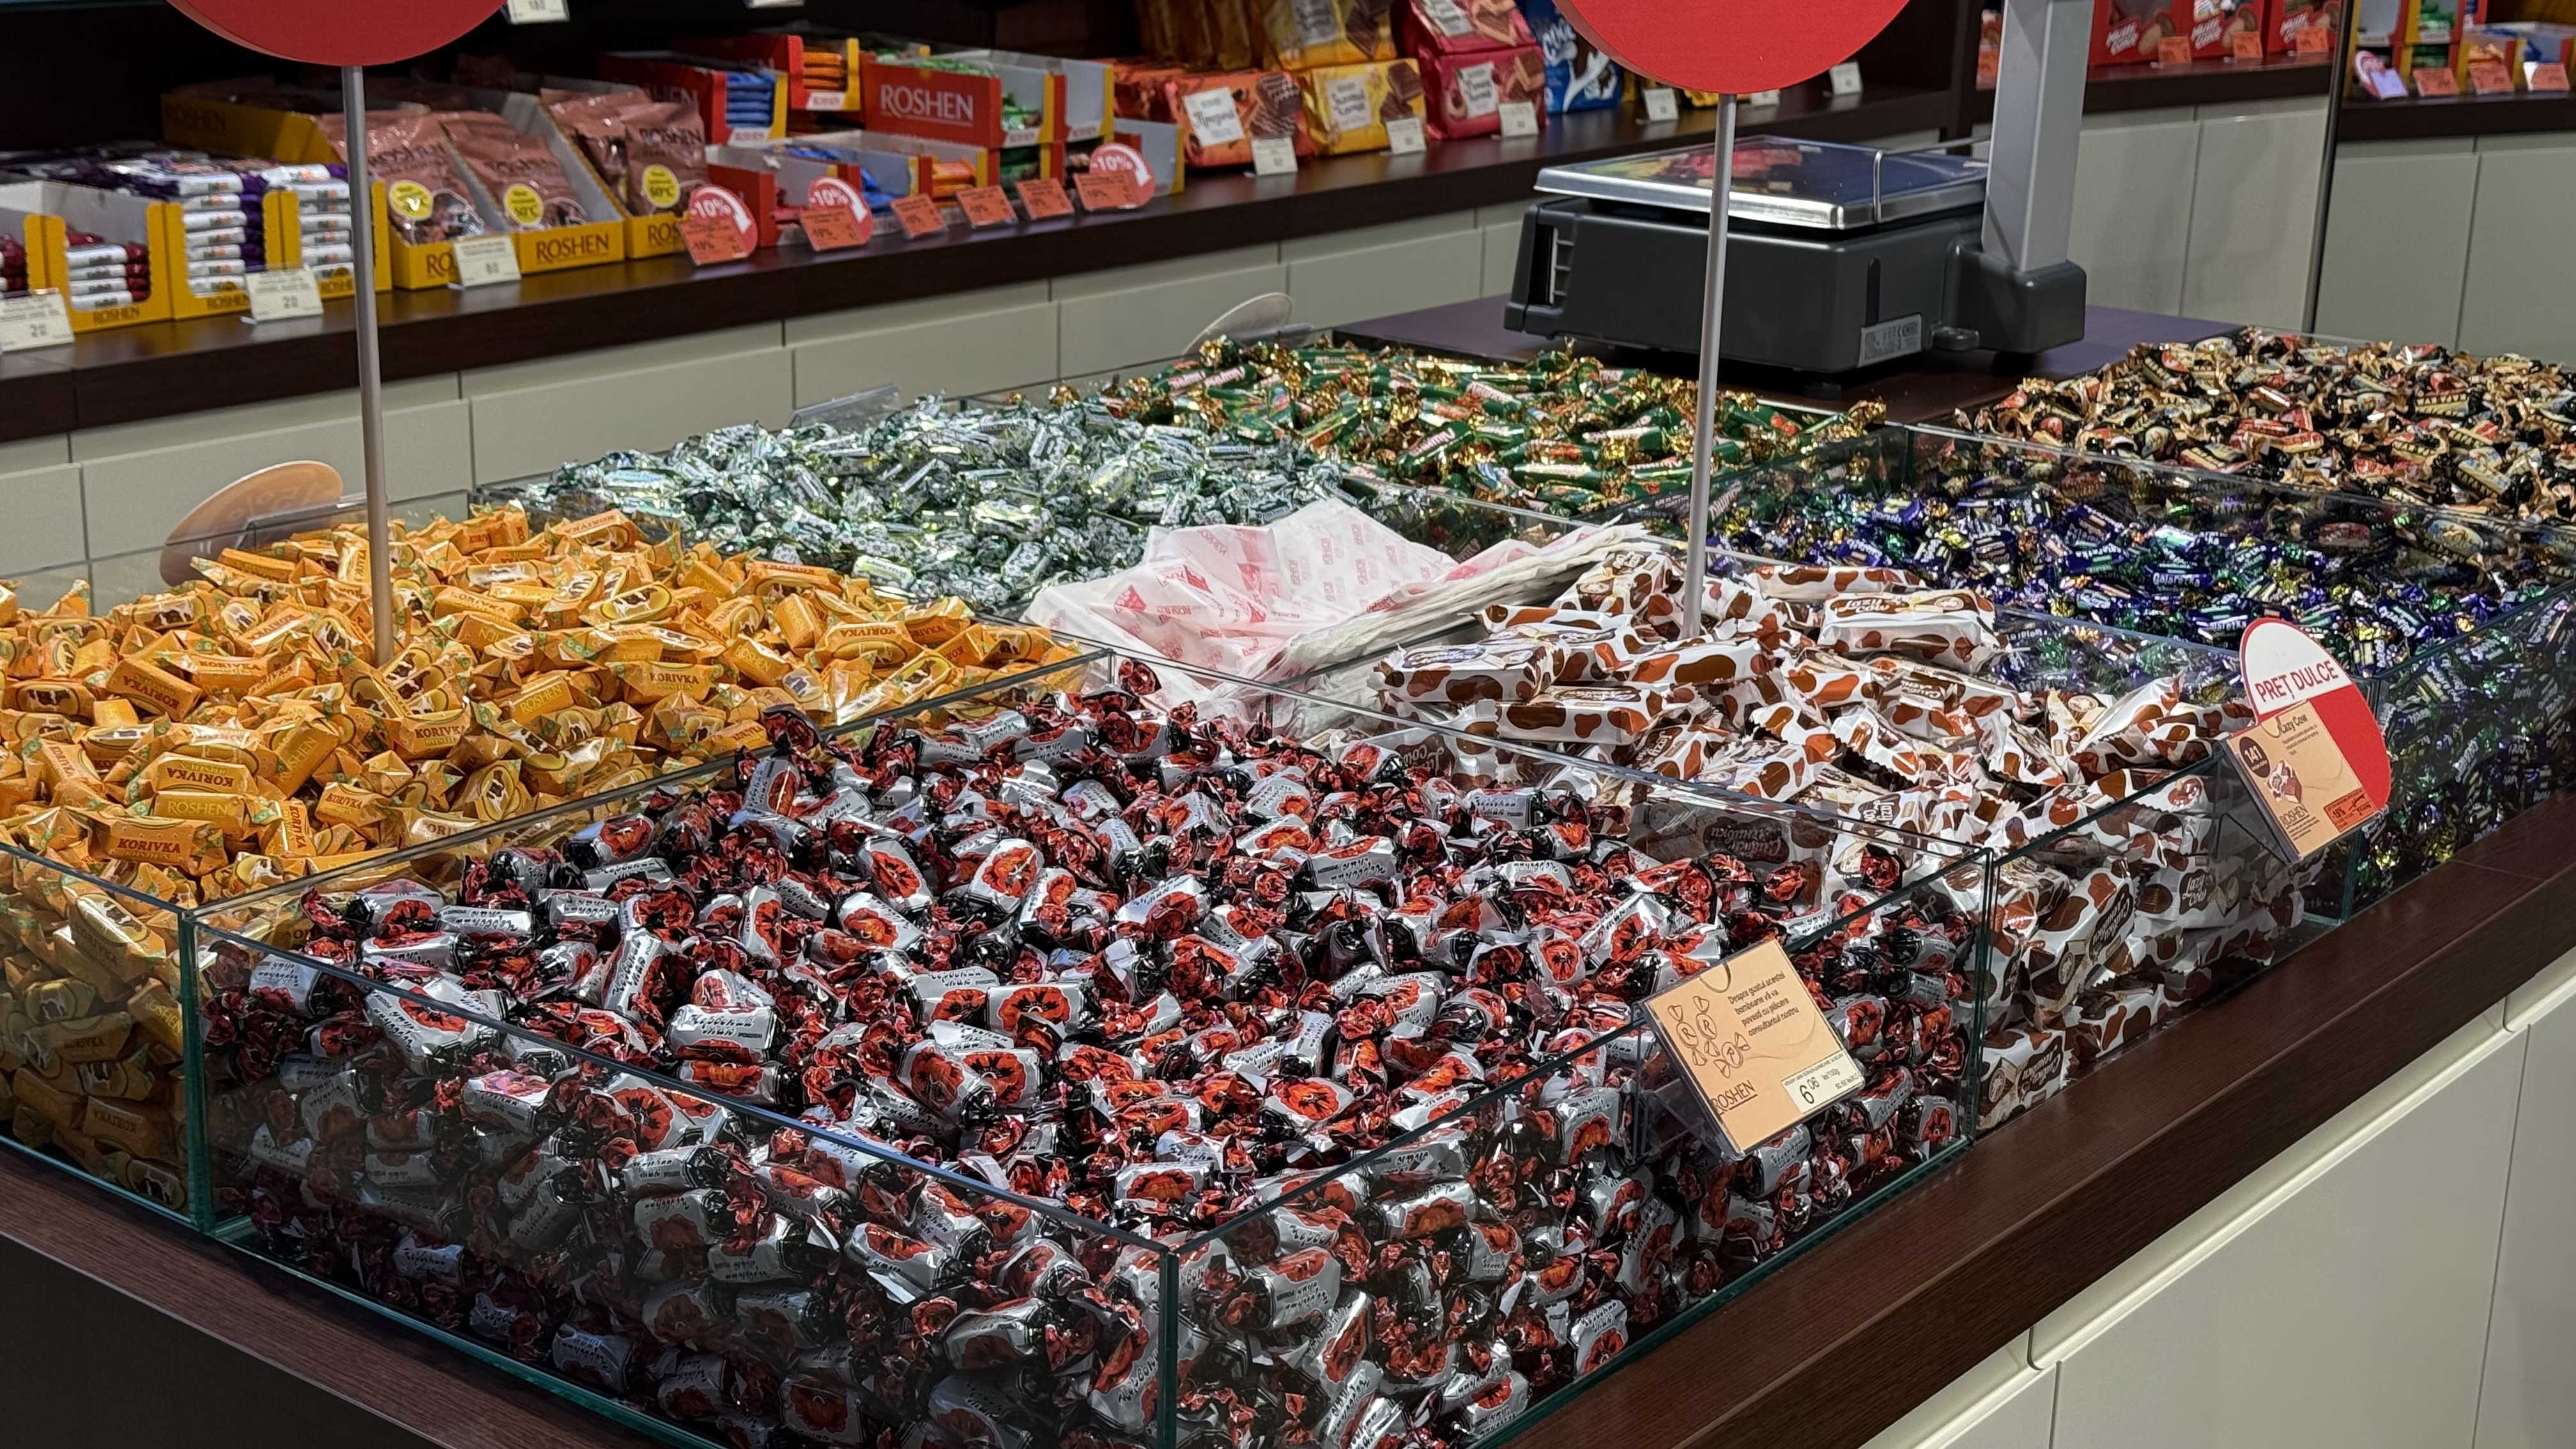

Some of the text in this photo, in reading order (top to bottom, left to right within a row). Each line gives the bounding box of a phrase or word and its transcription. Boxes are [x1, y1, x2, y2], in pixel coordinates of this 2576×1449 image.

[880, 83, 973, 120] ROSHEN
[1091, 156, 1133, 171] -10%
[809, 189, 848, 206] -10%
[691, 199, 732, 218] -10%
[647, 222, 682, 247] ROS
[535, 234, 609, 263] ROSHEN
[93, 306, 140, 325] ROSHEN
[564, 514, 615, 534] KORIVKA
[450, 591, 506, 614] KORIVKA
[1835, 597, 1885, 611] Lazy
[1857, 603, 1892, 615] cow
[839, 627, 896, 638] KORIVKA
[735, 645, 772, 671] ROSHEN
[649, 672, 700, 685] KORIVKA
[2255, 660, 2339, 700] PREȚ DULCE
[123, 675, 180, 710] KORIVKA
[520, 686, 563, 715] ROSHEN
[415, 725, 466, 739] KORIVKA
[2244, 744, 2262, 765] 141
[167, 767, 234, 788] KORIVKA
[167, 801, 229, 816] ROSHEN
[325, 792, 364, 811] KORIVKA
[2280, 804, 2308, 827] ROSHEN
[289, 804, 309, 850] KORIVKA
[116, 838, 182, 854] KORIVKA
[2185, 873, 2206, 901] Lazy
[2188, 889, 2208, 907] cow
[1728, 990, 1750, 1004] Despre
[1748, 979, 1767, 997] gustul
[1733, 996, 1765, 1015] bomboane
[1780, 1006, 1800, 1020] nostru
[2031, 1052, 2061, 1086] Сливки
[1711, 1079, 1757, 1113] ROSHEN
[1799, 1076, 1820, 1105] 6 06
